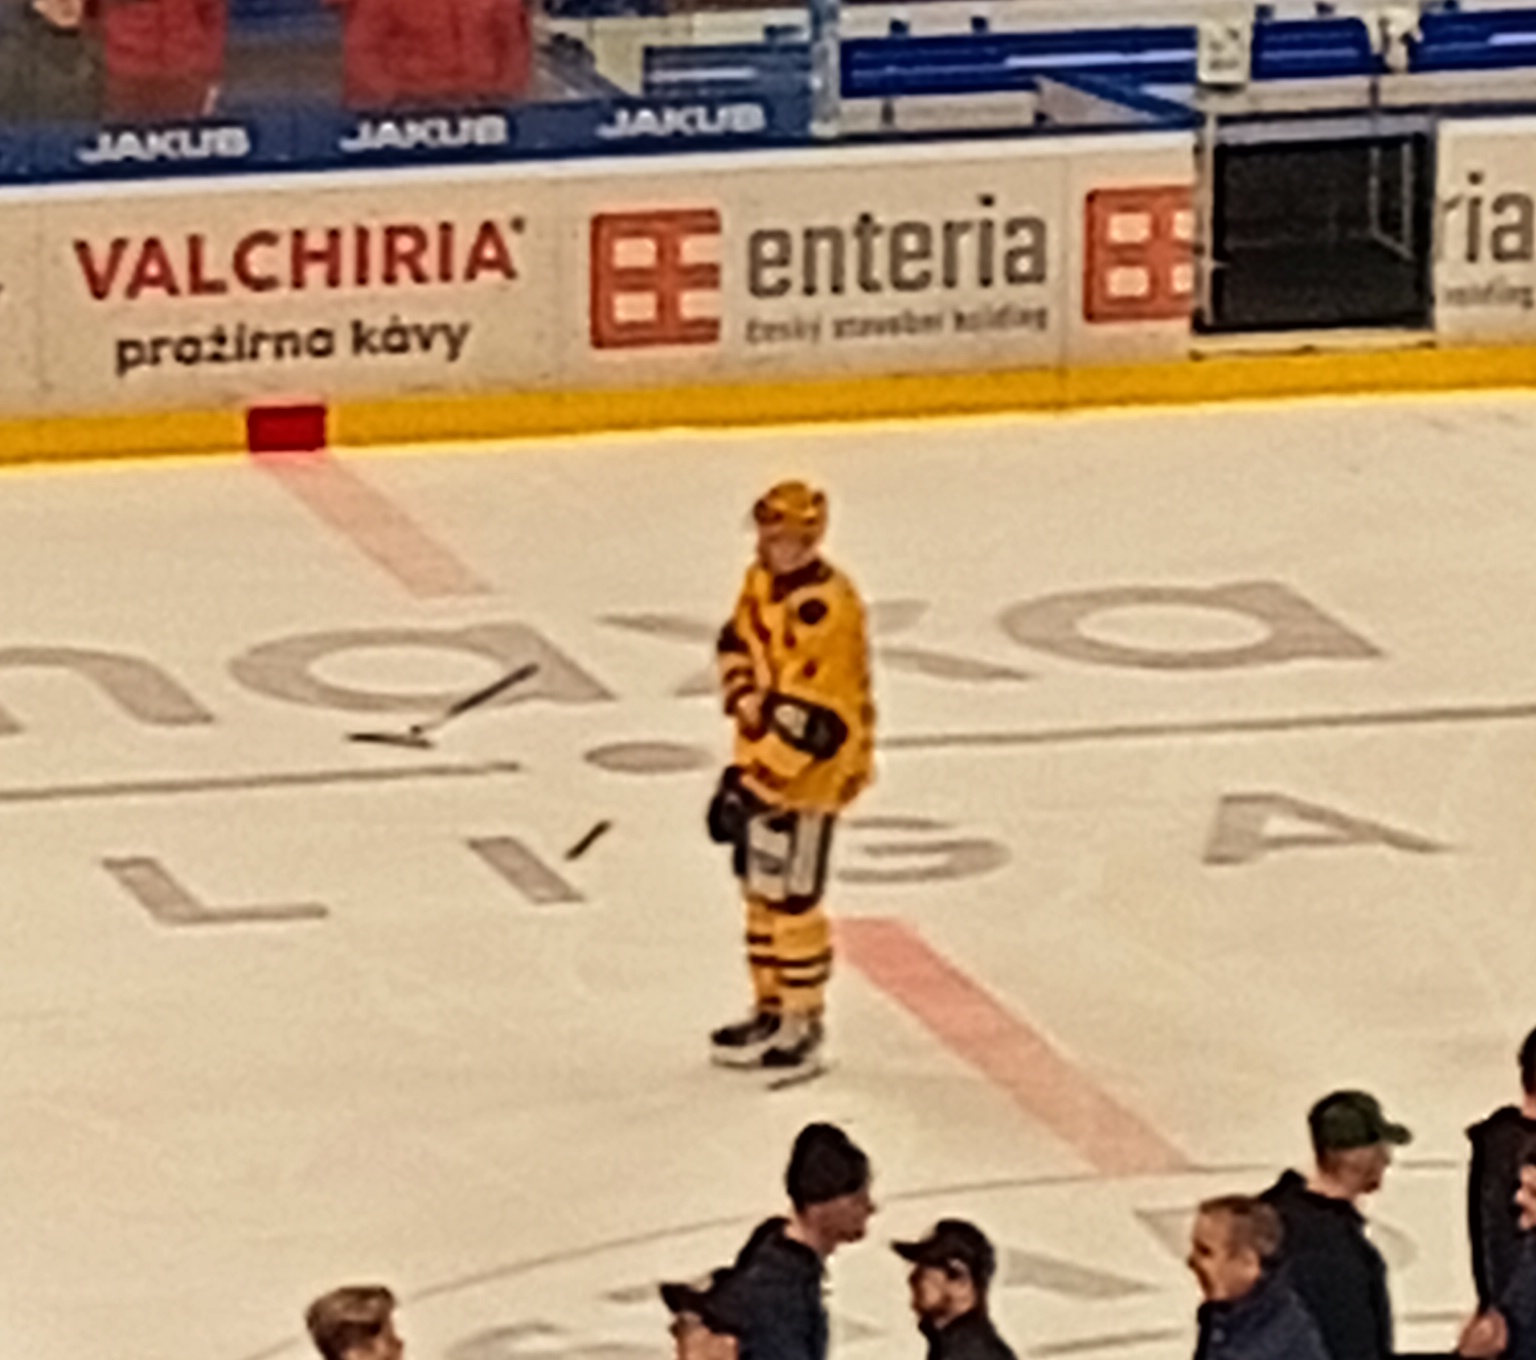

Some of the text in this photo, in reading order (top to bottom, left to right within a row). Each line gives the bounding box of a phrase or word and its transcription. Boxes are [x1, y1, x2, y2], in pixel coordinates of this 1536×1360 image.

[76, 127, 250, 163] JAKUB
[338, 115, 509, 152] JAKUB
[595, 103, 767, 139] JAKUB
[73, 218, 520, 301] VALCHIRIA
[747, 194, 1048, 299] enteria
[115, 314, 471, 377] pražírna kávy
